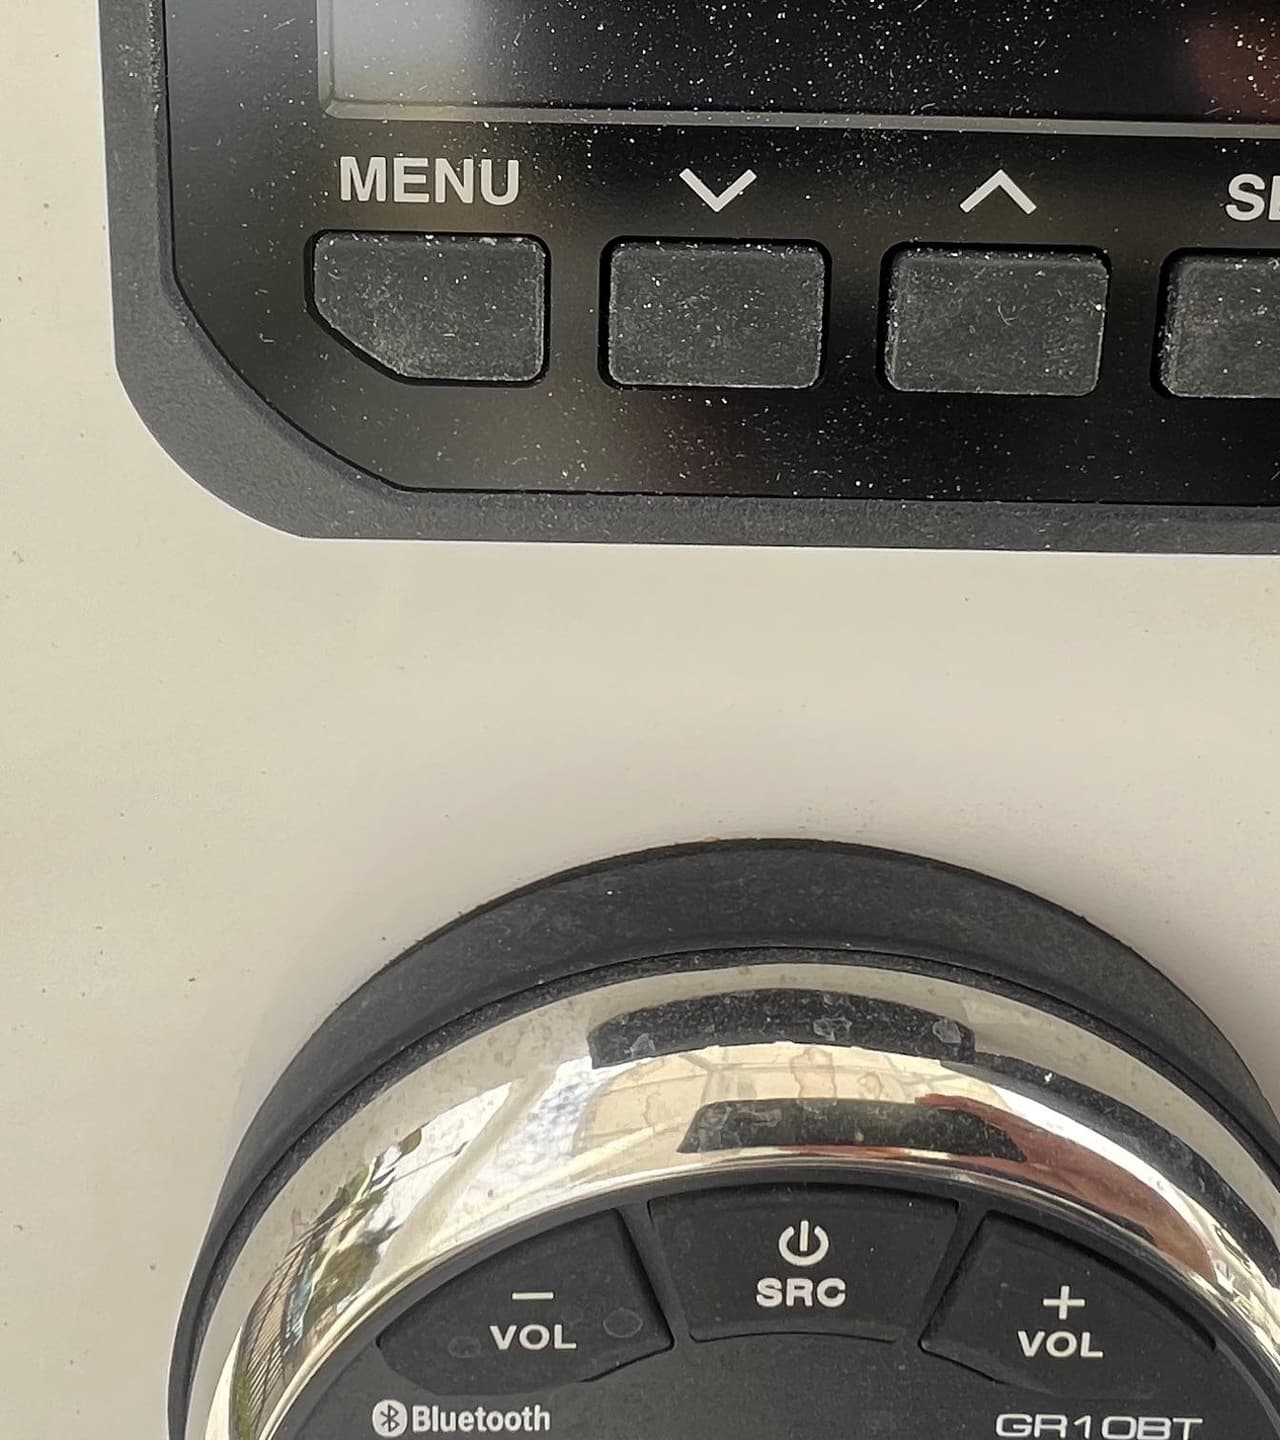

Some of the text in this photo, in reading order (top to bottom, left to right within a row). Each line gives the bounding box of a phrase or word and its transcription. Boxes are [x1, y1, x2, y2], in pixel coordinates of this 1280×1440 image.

[338, 153, 521, 207] MENU
[755, 1276, 847, 1309] SRC
[488, 1323, 578, 1351] VOL
[1016, 1329, 1105, 1359] VOL
[411, 1404, 551, 1433] Bluetooth
[994, 1412, 1204, 1440] GR10BT
